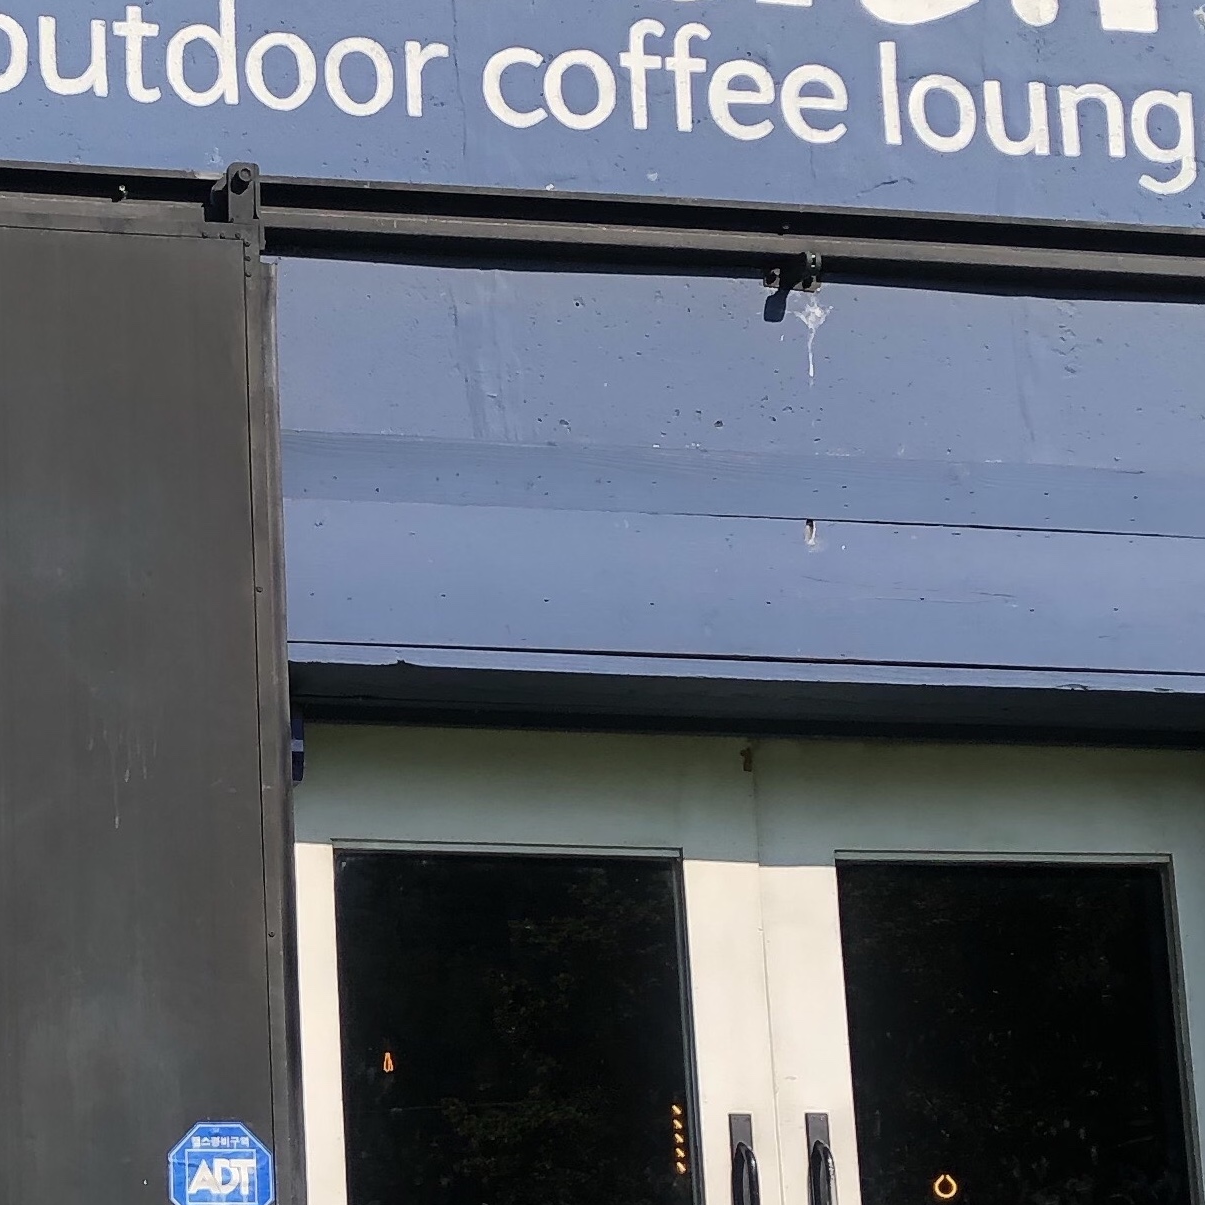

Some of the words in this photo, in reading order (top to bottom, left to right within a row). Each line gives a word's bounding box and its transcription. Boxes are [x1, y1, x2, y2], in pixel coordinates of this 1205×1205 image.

[482, 18, 848, 144] coffee
[878, 41, 1197, 196] loung
[188, 1157, 255, 1196] ADT
